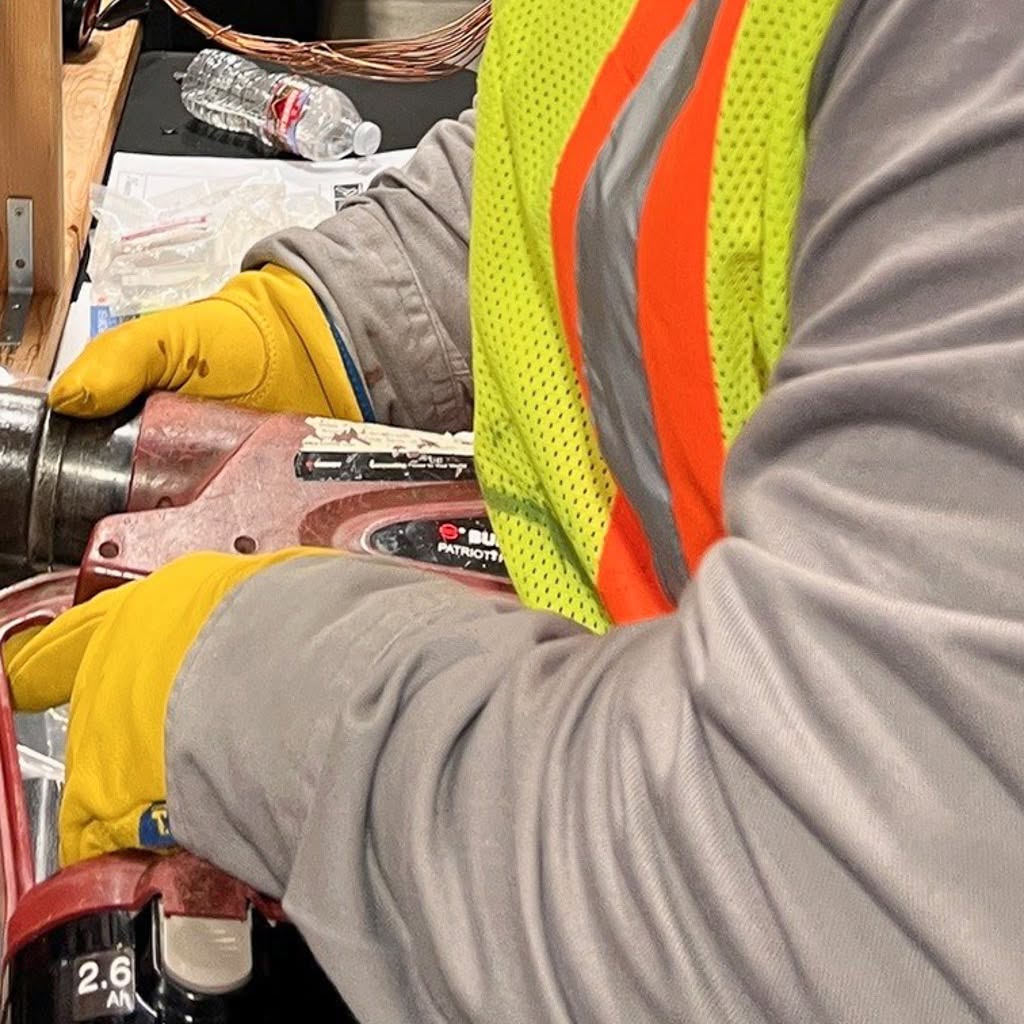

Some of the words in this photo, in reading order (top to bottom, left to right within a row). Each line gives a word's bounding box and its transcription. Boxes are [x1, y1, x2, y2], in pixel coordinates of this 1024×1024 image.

[468, 528, 502, 549] BU
[78, 955, 132, 996] 2.6
[106, 989, 134, 1012] Ah
